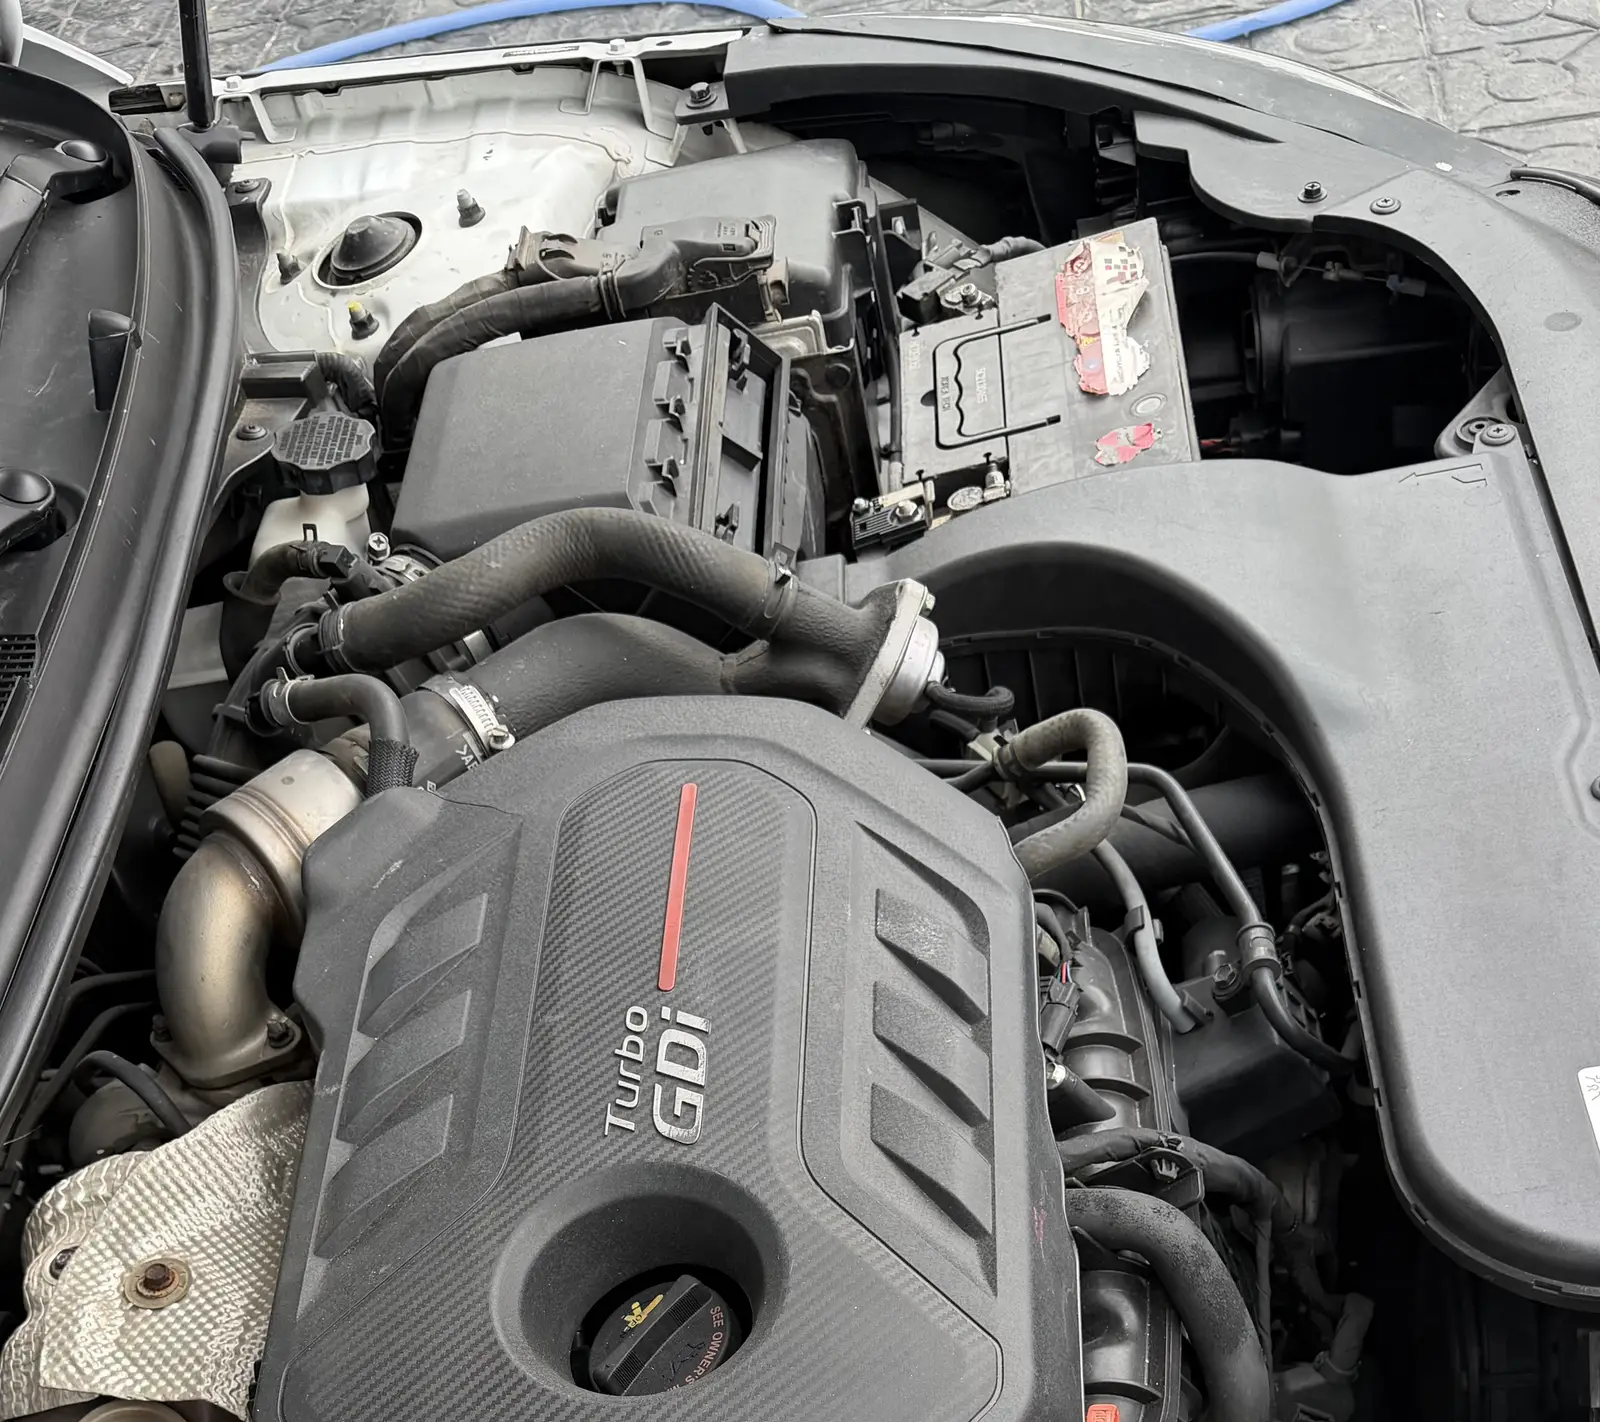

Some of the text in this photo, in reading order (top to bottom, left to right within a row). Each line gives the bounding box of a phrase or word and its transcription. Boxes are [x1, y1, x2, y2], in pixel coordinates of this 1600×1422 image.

[604, 1006, 649, 1137] Turbo
[652, 1006, 712, 1145] GDi
[685, 1305, 724, 1385] SEE OWNER'S
